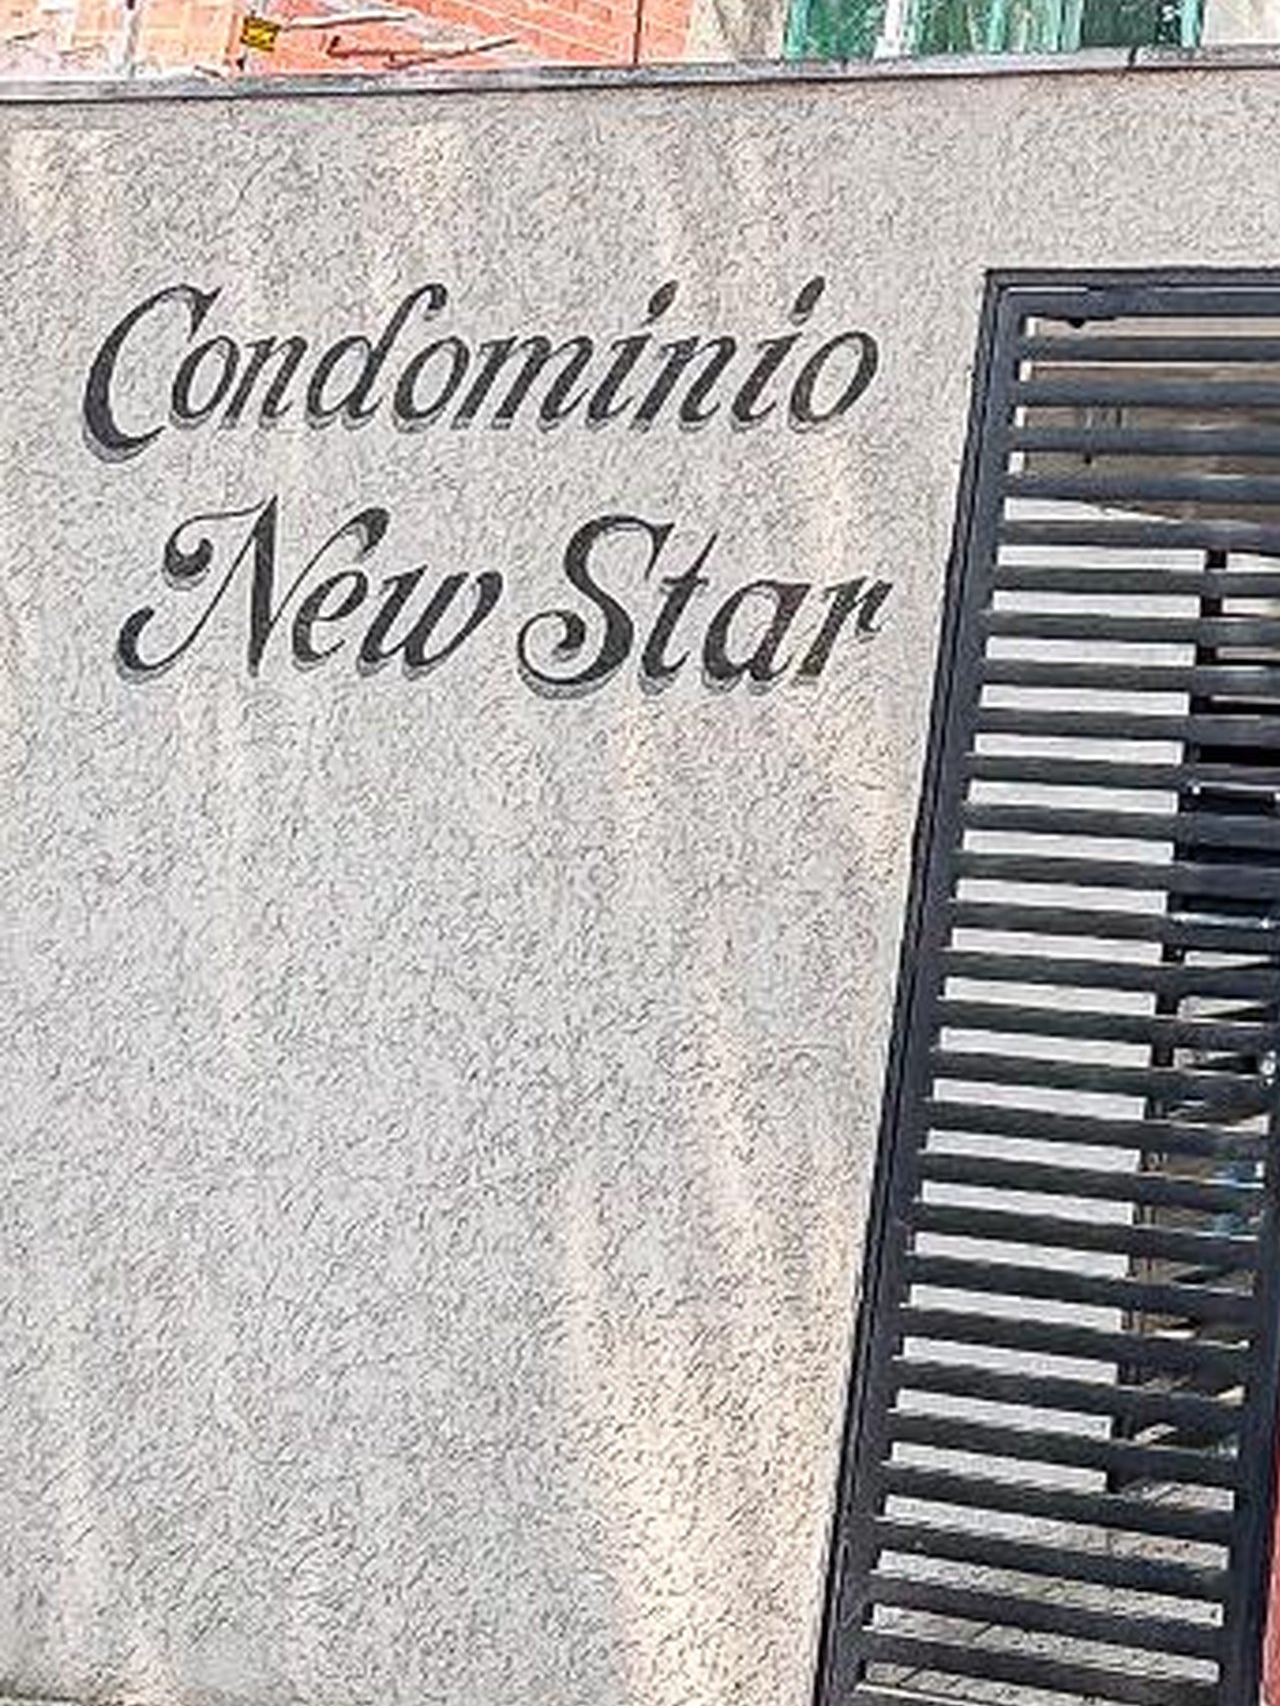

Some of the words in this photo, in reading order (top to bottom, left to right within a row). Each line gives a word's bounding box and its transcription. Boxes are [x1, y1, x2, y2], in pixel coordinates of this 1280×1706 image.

[81, 276, 881, 463] Condominio
[115, 493, 505, 684] New
[516, 514, 894, 700] Star
